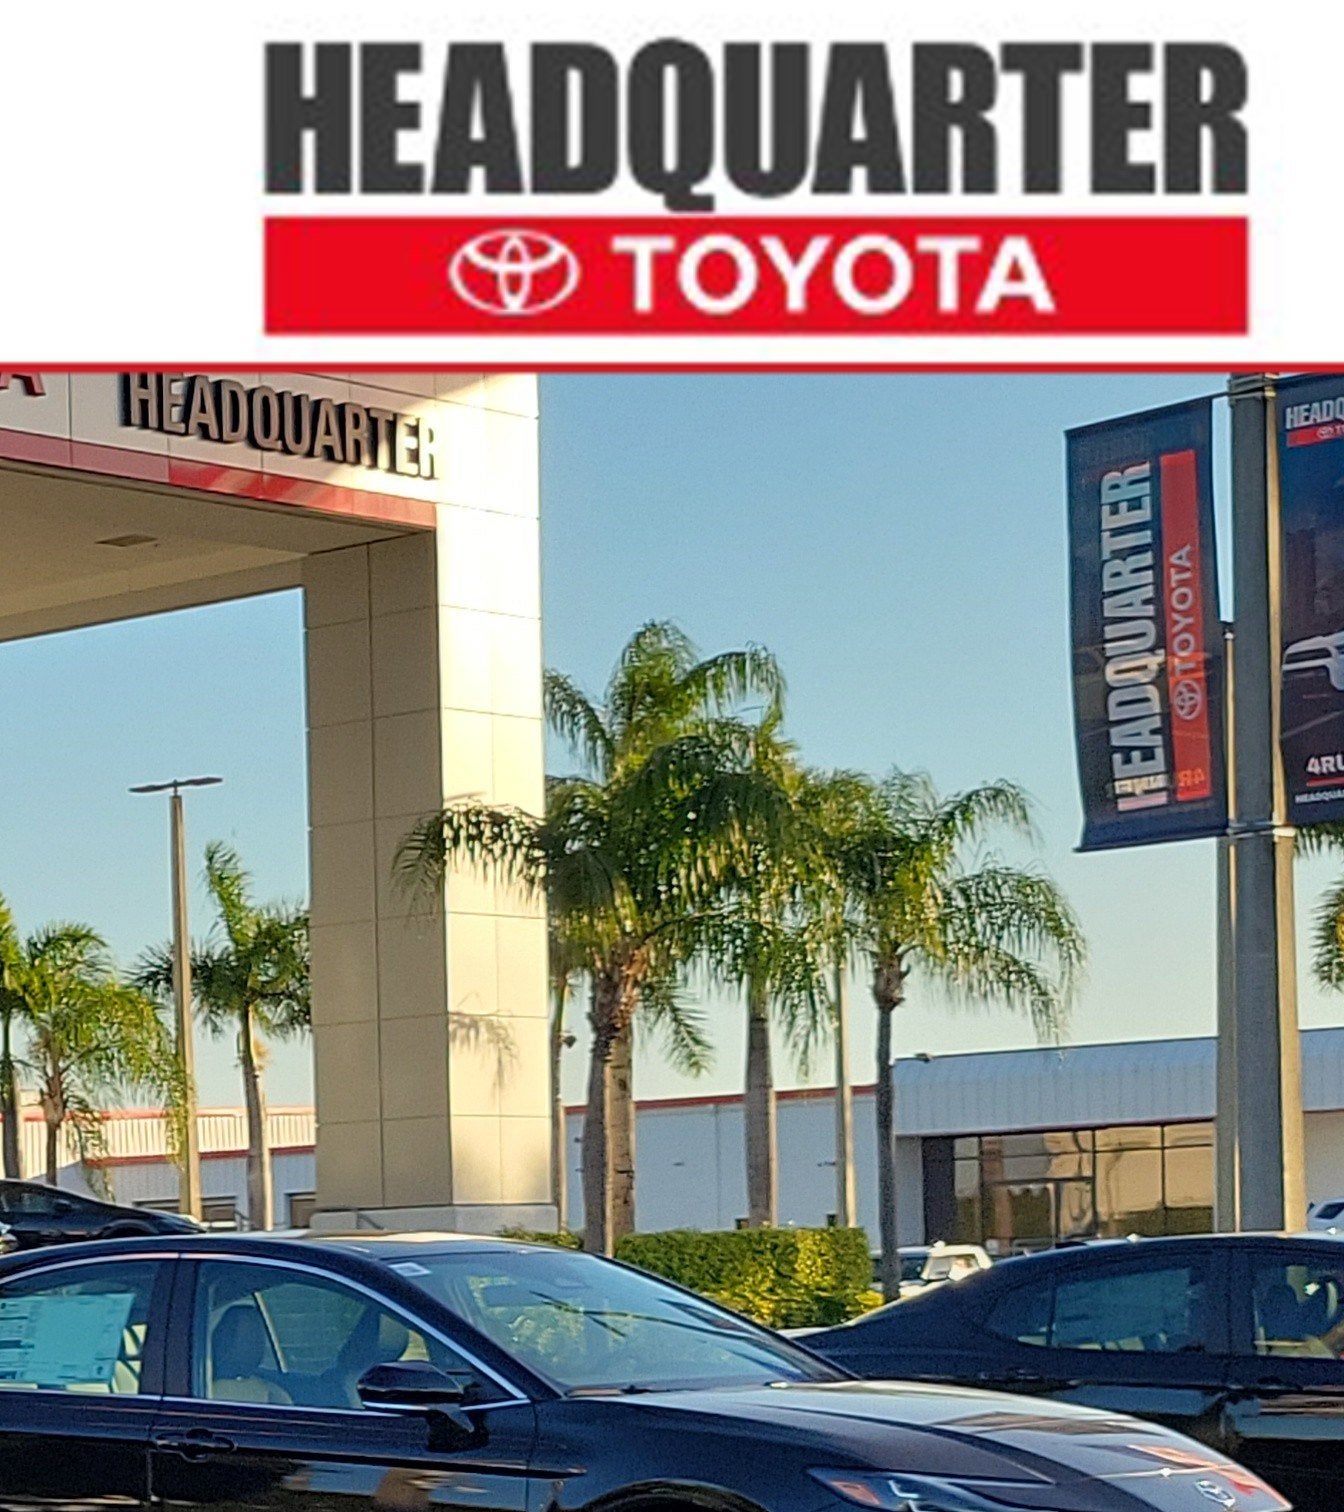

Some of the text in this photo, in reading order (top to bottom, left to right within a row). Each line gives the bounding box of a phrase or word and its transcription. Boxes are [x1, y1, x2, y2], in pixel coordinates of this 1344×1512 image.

[121, 373, 435, 479] HEADQUARTER
[1100, 461, 1167, 811] HEADQUARTER
[1170, 545, 1196, 676] TOYOTA
